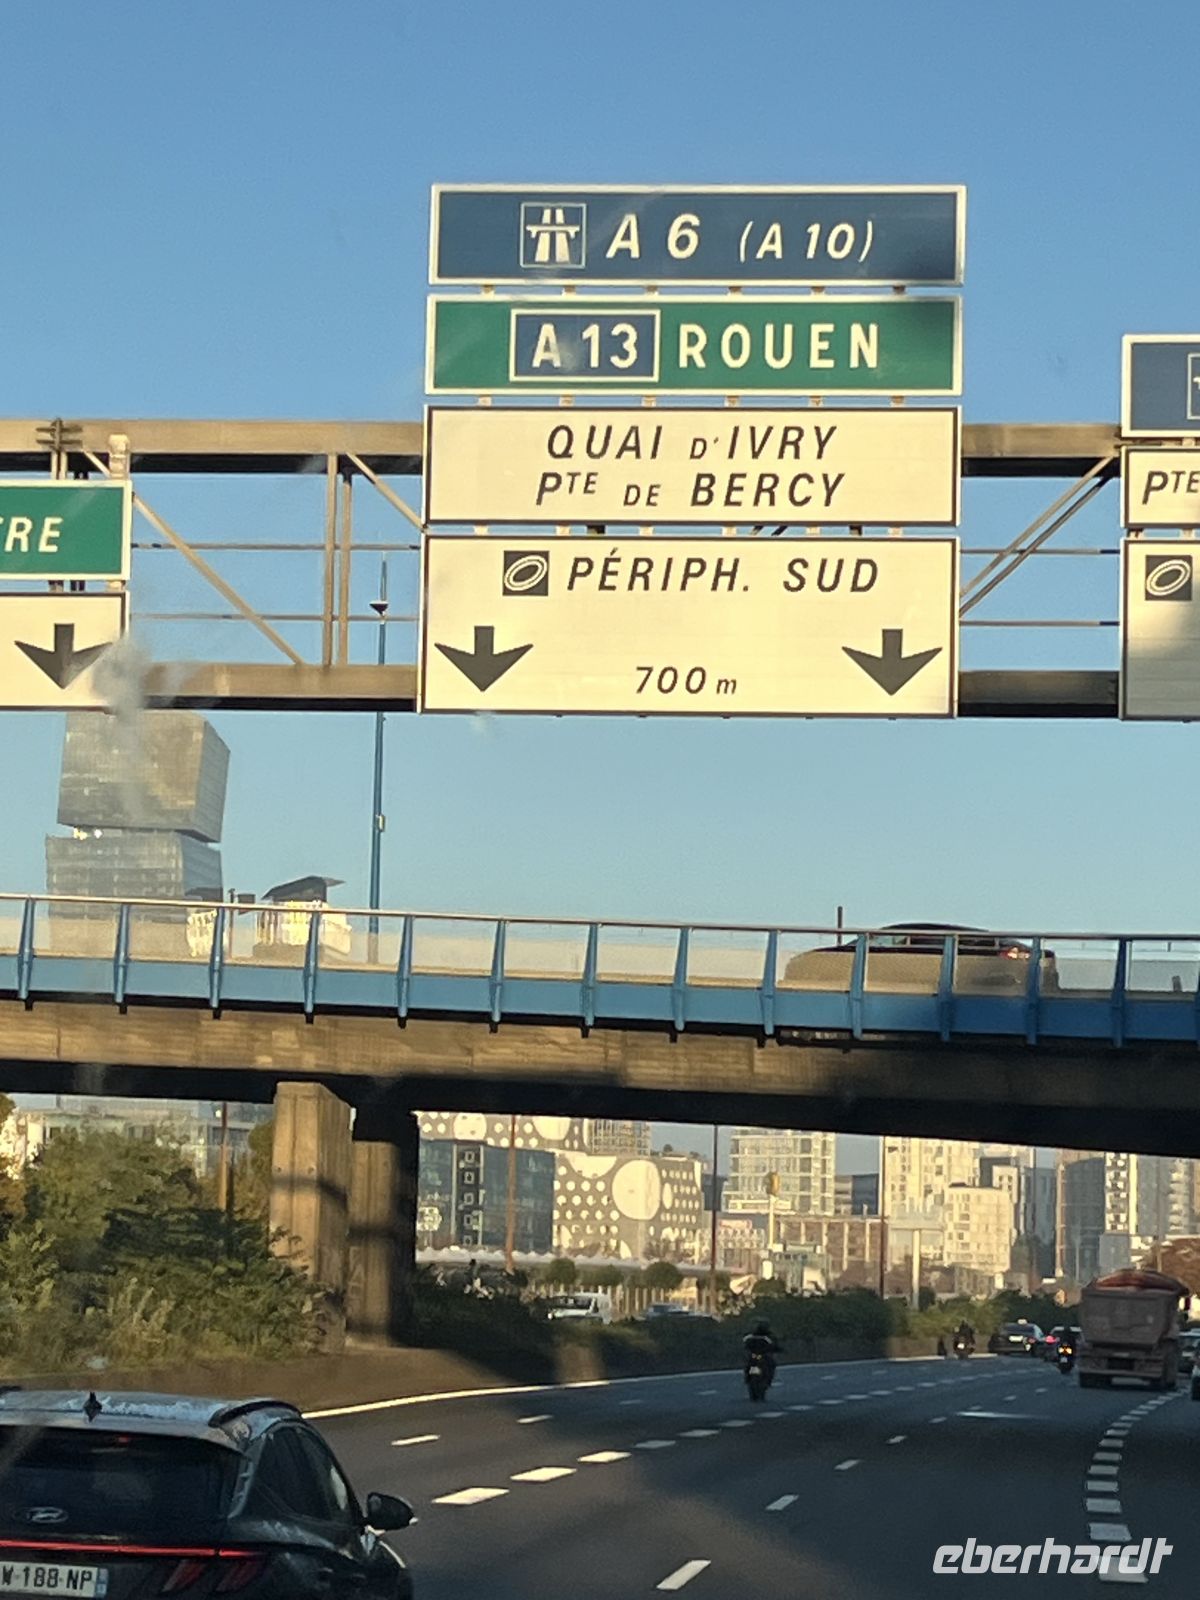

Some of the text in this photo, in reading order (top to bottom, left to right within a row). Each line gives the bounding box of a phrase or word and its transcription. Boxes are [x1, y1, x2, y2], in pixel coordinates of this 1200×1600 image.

[605, 213, 873, 263] A 6 (A 10)
[532, 323, 877, 369] A 13 ROUEN
[547, 425, 662, 460] QUAI
[535, 471, 846, 507] PTE DE BERCY
[0, 516, 64, 553] RE
[566, 547, 879, 593] PÉRIPH. SUD
[636, 666, 737, 695] 700 m
